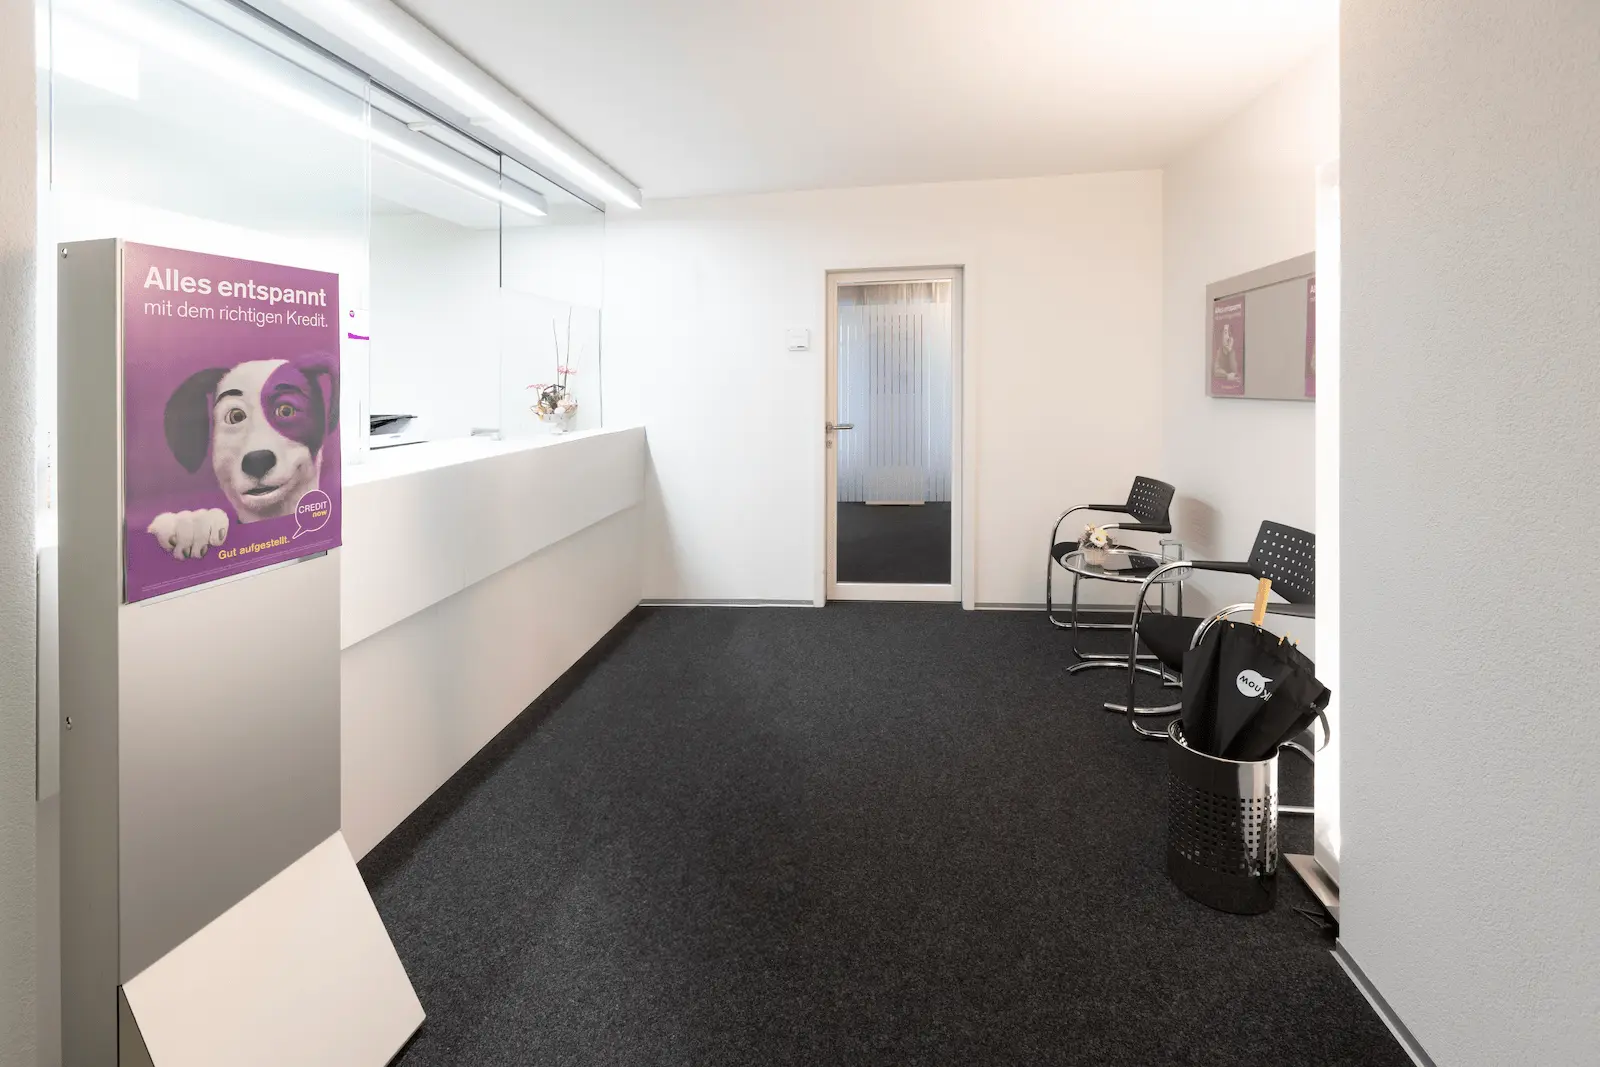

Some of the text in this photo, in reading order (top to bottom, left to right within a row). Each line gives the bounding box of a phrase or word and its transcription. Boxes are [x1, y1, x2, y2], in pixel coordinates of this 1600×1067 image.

[144, 266, 327, 307] Alles entspannt
[144, 300, 328, 328] mit dem richtigen Kredit.
[298, 501, 328, 514] CREDIT
[312, 510, 328, 518] now
[218, 536, 290, 560] Gut aufgestellt.
